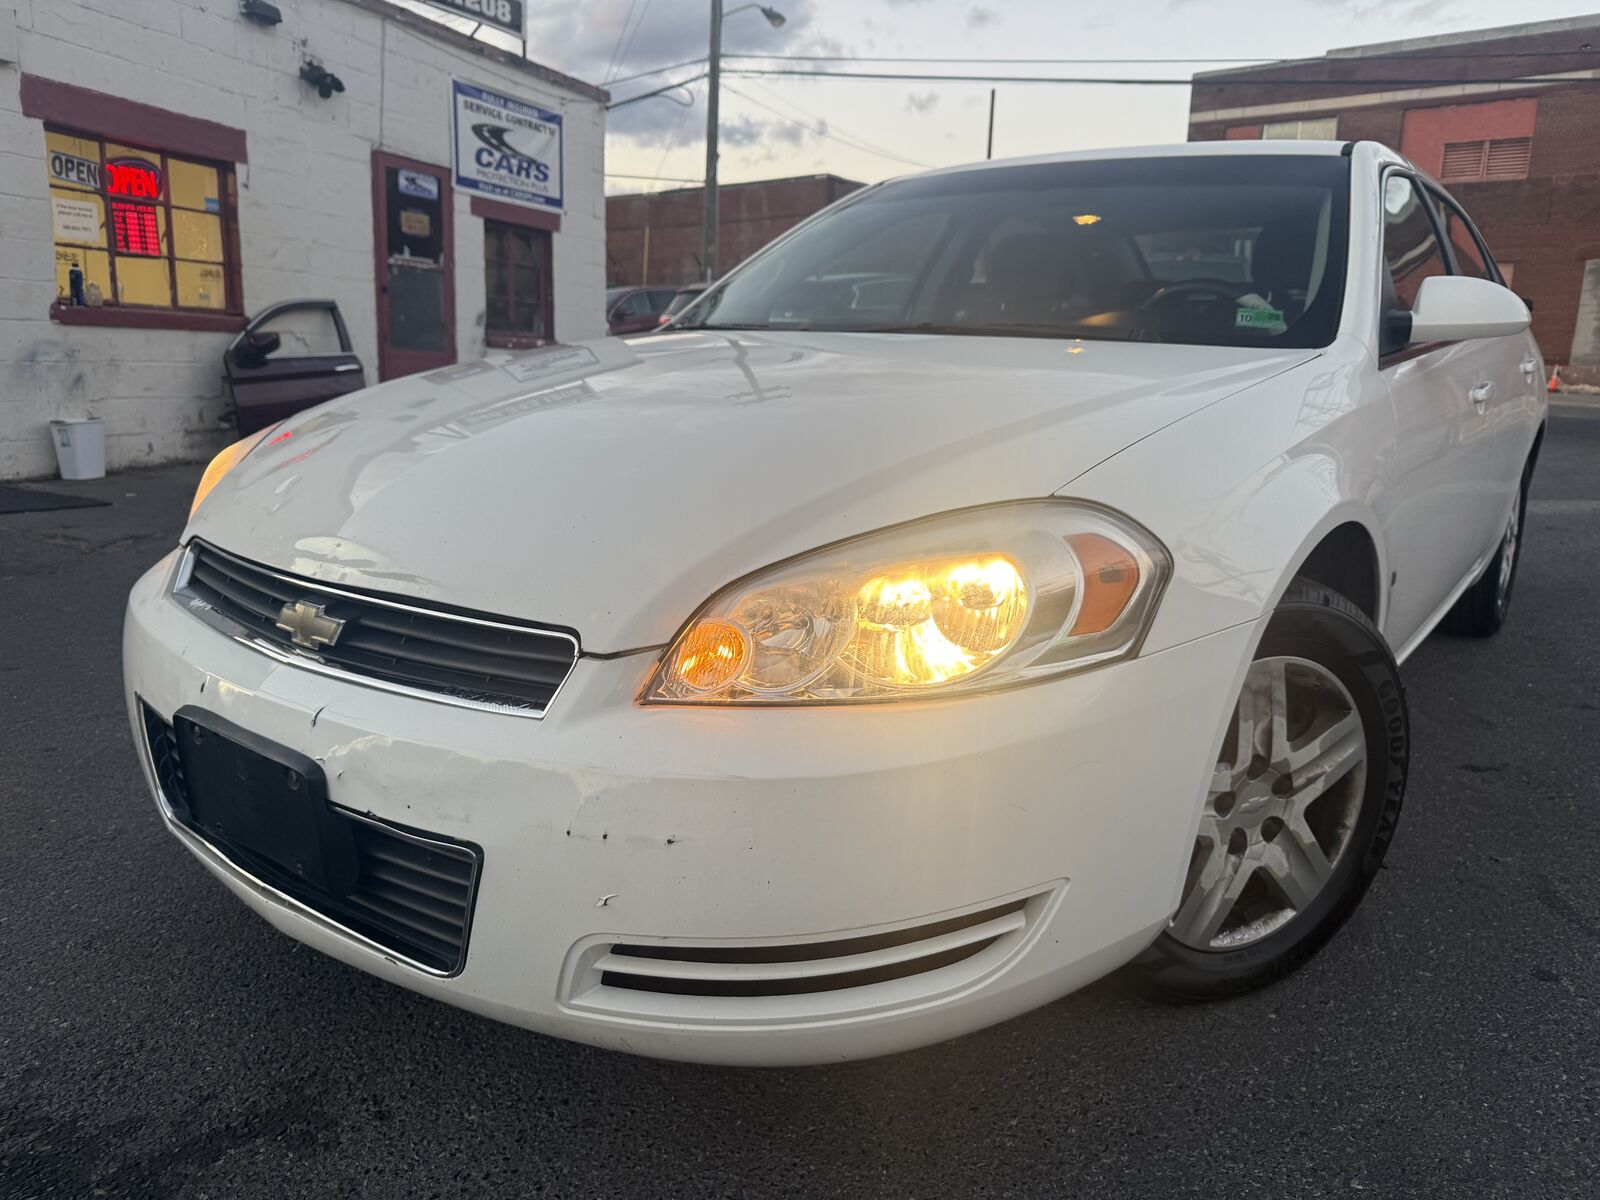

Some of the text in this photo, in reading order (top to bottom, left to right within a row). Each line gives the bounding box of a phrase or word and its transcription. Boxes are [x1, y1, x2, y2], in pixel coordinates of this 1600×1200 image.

[463, 98, 504, 121] SERVICE
[52, 155, 98, 186] OPEN
[475, 147, 550, 183] CARS
[477, 168, 530, 188] PROTECTION
[106, 164, 157, 198] OPEN
[1239, 314, 1253, 323] 10
[1370, 678, 1403, 858] GOODYEAR
